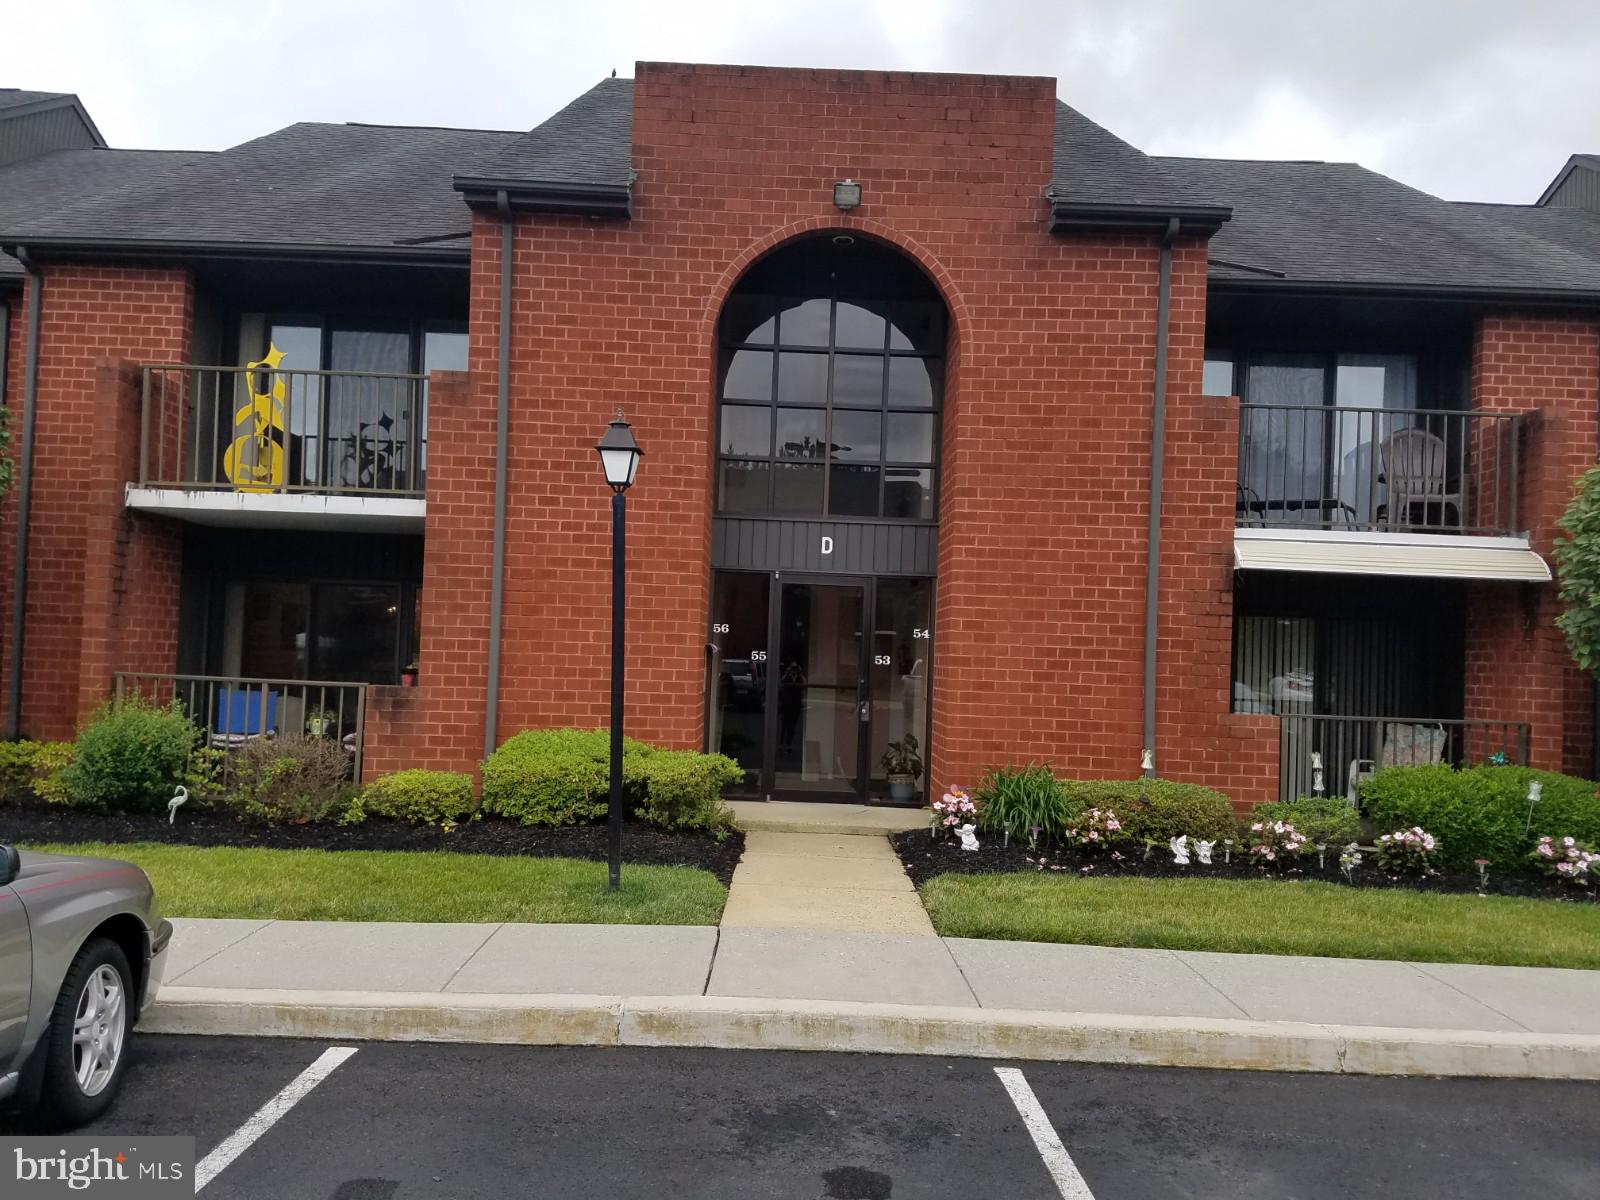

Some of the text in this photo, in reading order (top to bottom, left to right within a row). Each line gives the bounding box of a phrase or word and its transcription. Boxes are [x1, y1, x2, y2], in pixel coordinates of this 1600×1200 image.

[821, 536, 834, 554] D
[713, 623, 730, 634] 56
[913, 628, 931, 639] 54
[751, 651, 767, 661] 55
[874, 655, 891, 666] 53
